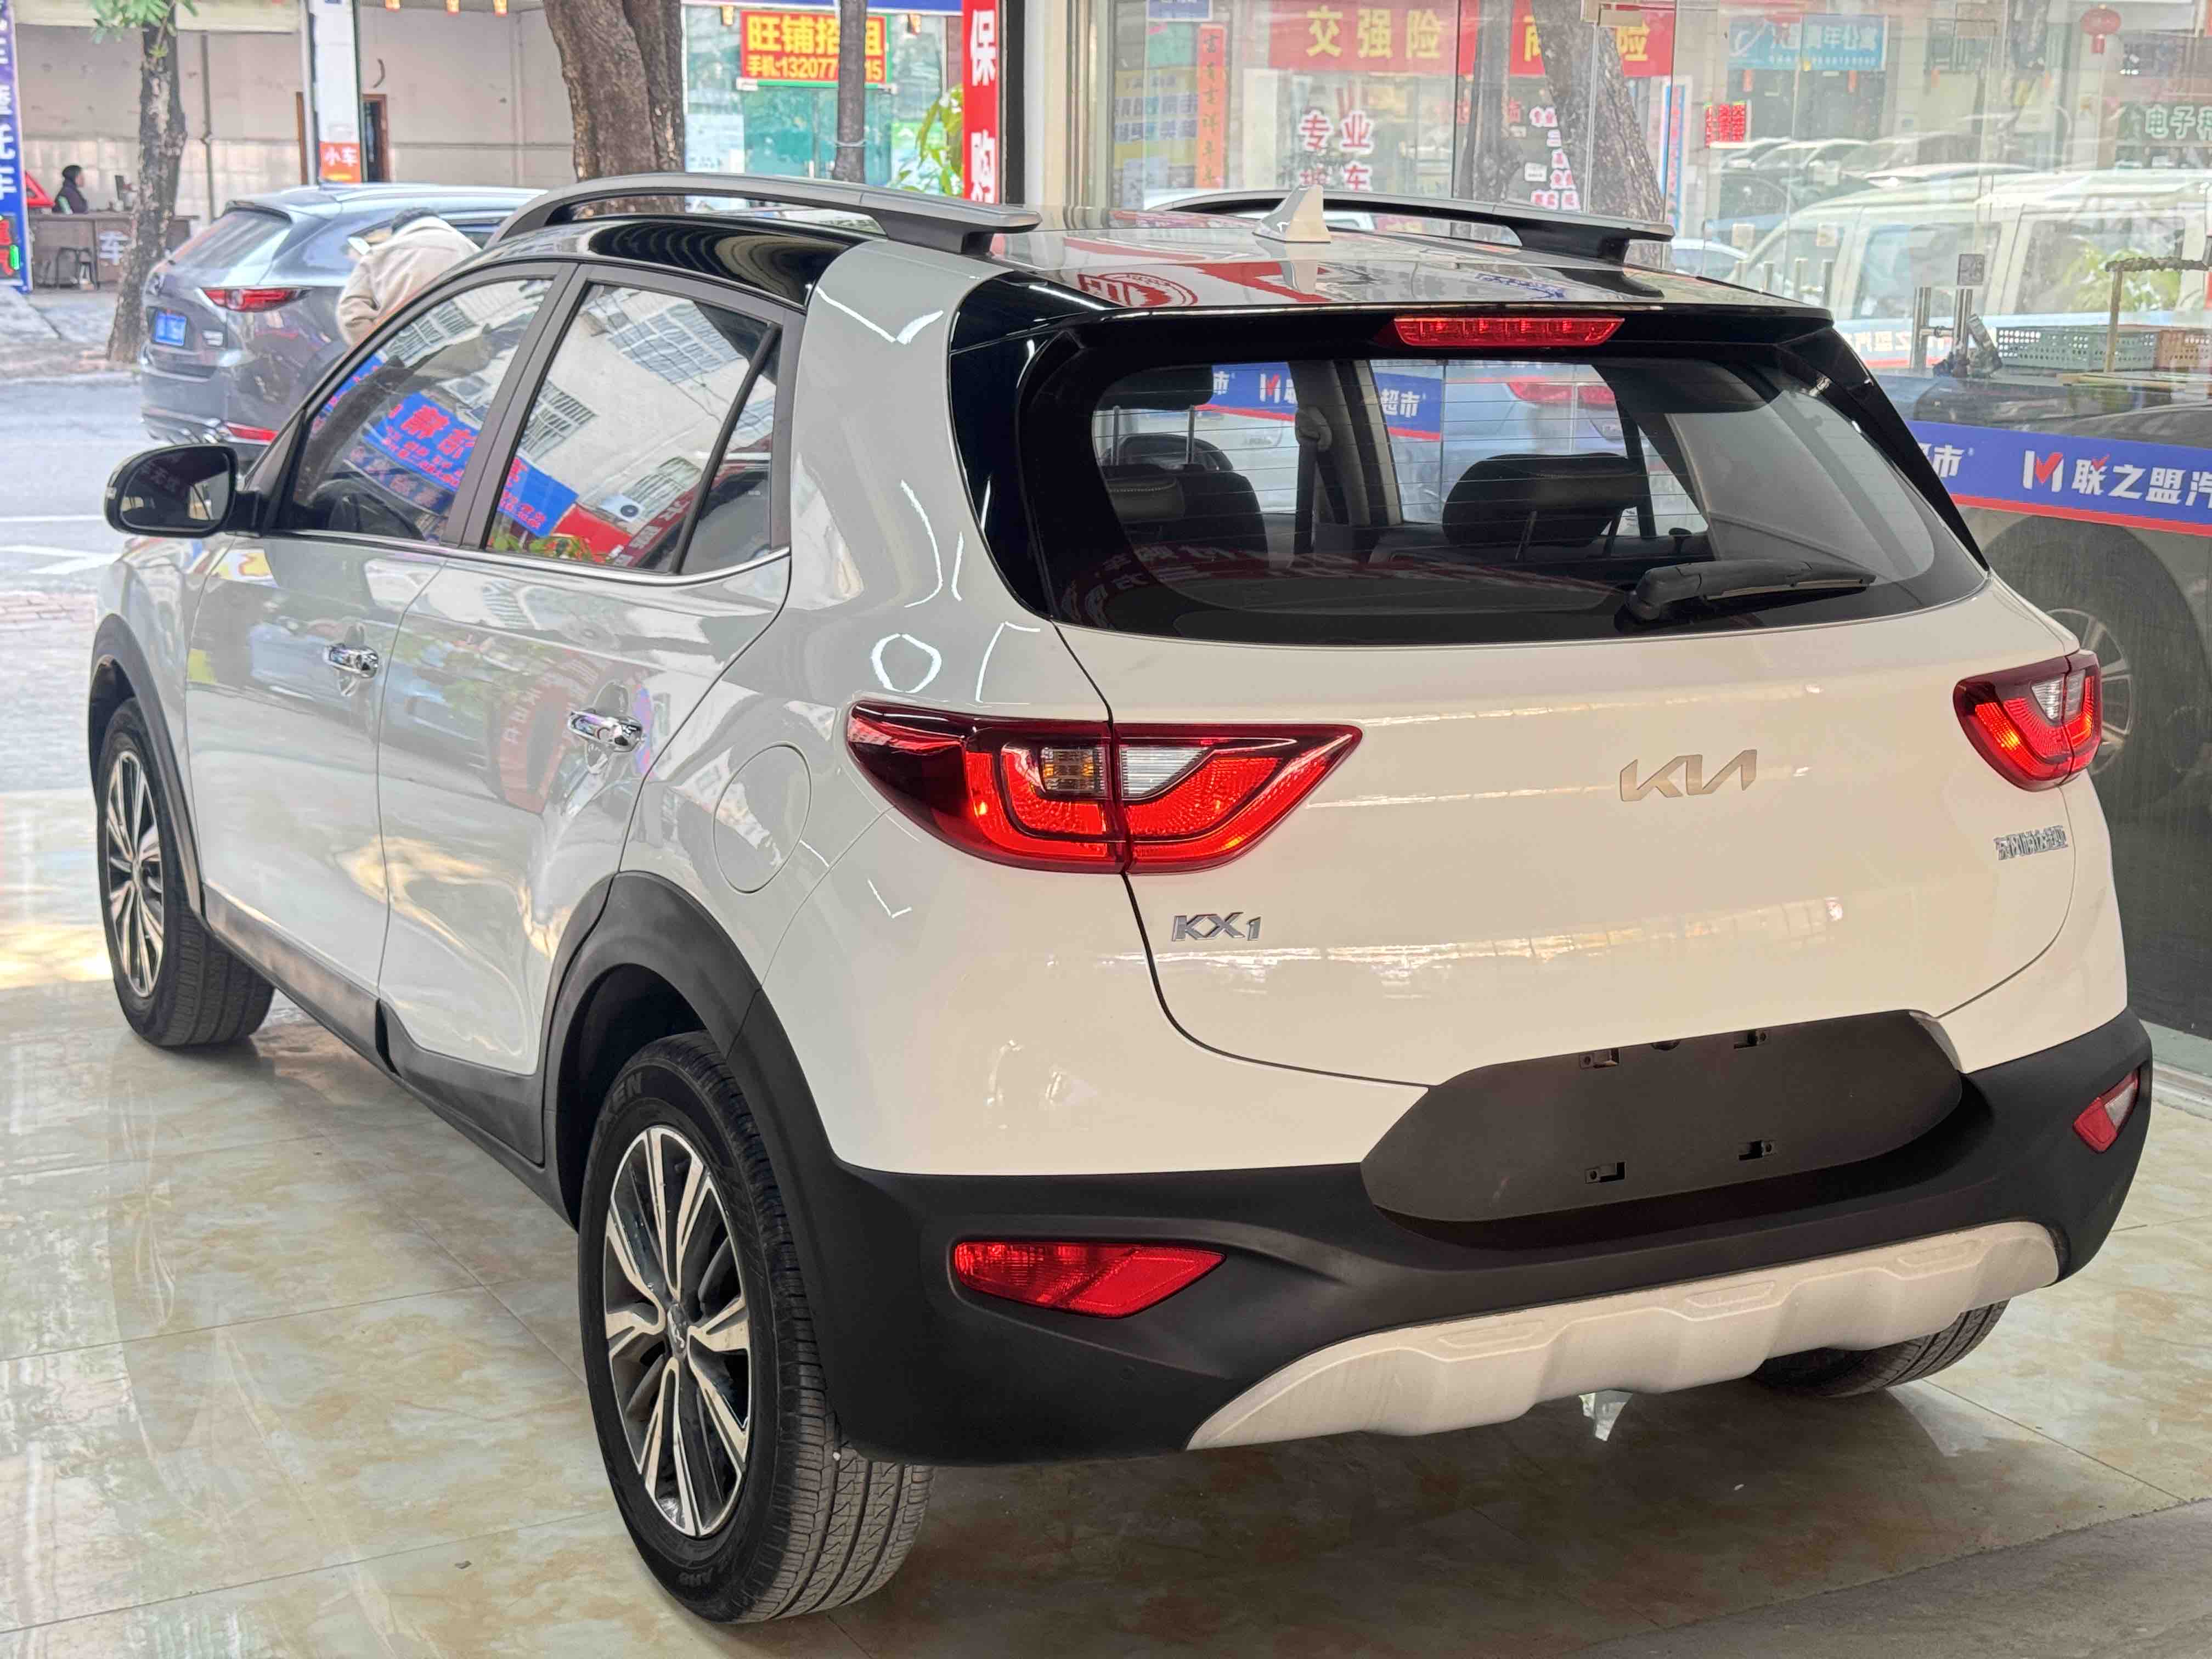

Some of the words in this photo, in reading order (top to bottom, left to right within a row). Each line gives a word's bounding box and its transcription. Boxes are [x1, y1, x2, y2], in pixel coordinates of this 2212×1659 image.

[1306, 5, 1441, 59] 交强险
[1301, 111, 1372, 149] 专业
[1380, 387, 1420, 418] 超市
[1620, 749, 1758, 802] KIA
[1172, 911, 1262, 942] KX1
